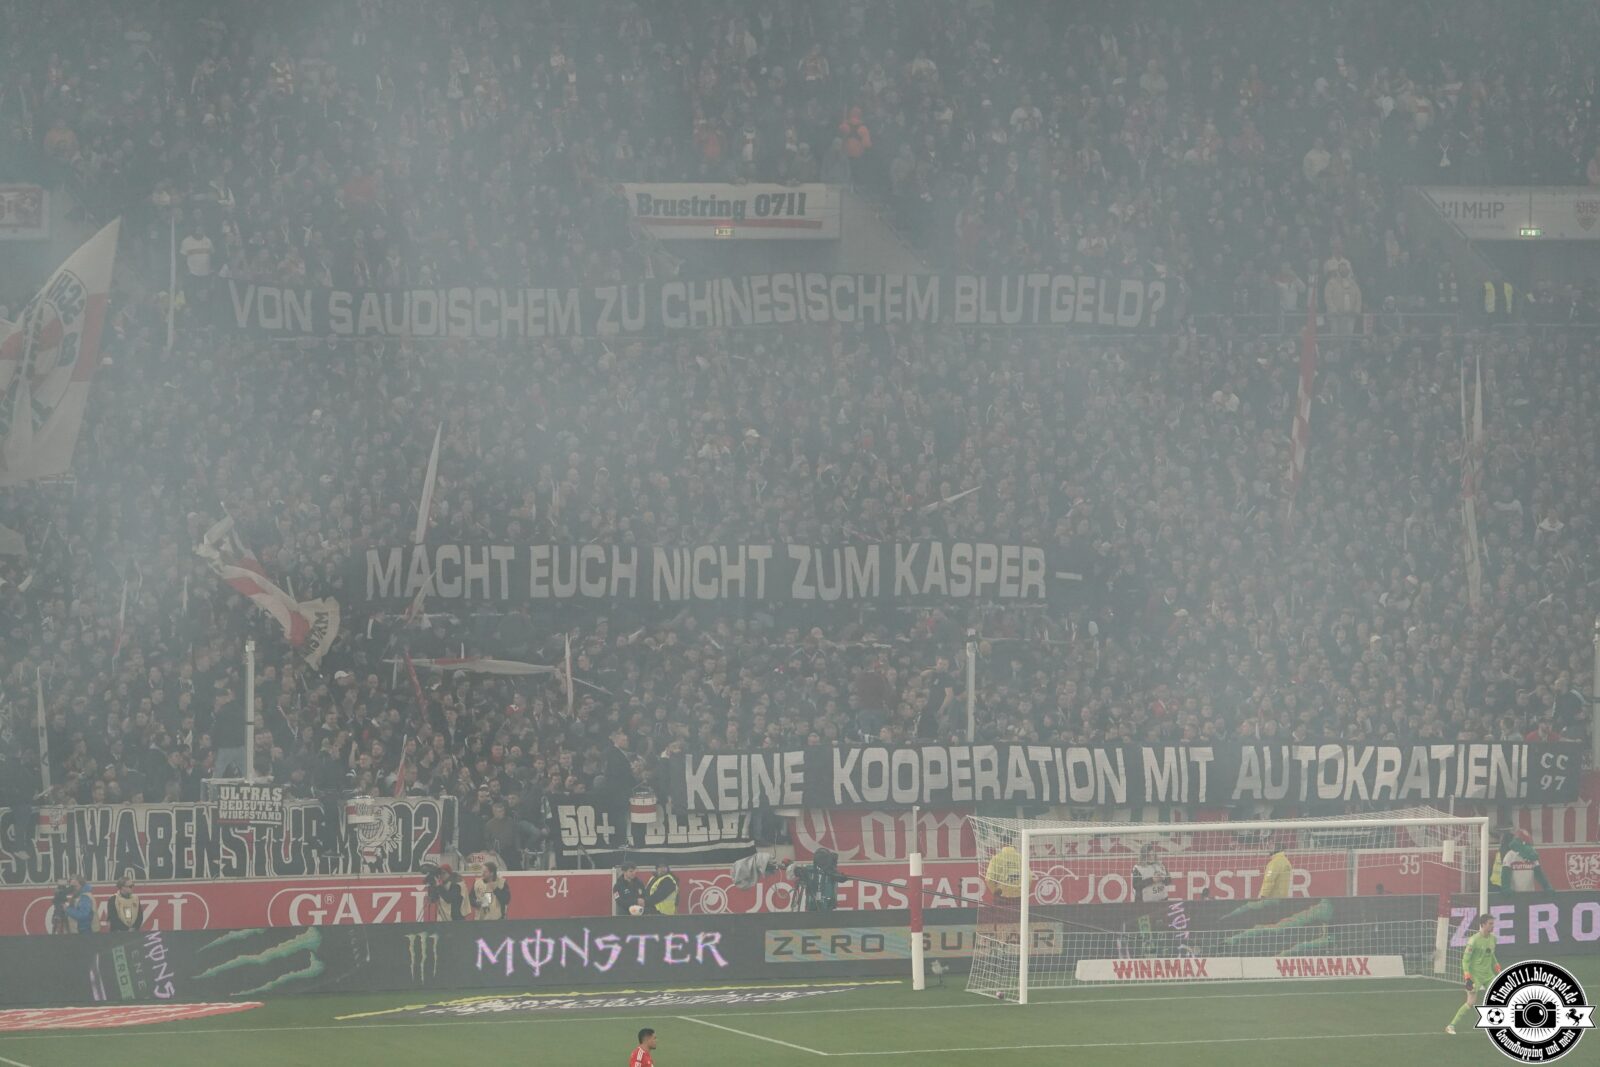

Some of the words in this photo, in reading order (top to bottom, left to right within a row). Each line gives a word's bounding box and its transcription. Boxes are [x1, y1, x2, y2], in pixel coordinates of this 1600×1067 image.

[636, 193, 746, 222] Brustring
[755, 192, 806, 217] 0711
[1462, 201, 1505, 219] MHP
[229, 279, 312, 331] VON
[329, 286, 581, 337] SAUDISCHEM
[594, 283, 646, 333] ZU
[661, 272, 939, 329] CHINESISCHEM
[954, 273, 1166, 327] BLUTGELD?
[366, 545, 515, 600] MACHT
[530, 545, 638, 599] EUCH
[653, 545, 772, 600] NICHT
[788, 544, 880, 600] ZUM
[894, 541, 1046, 599] KASPER
[1540, 752, 1569, 770] CC
[685, 751, 804, 811] KEINE
[832, 745, 1127, 804] KOOPERATION
[1142, 746, 1214, 803] MIT
[1231, 744, 1528, 801] AUTOKRATIEN!
[1540, 774, 1567, 790] 97
[220, 786, 283, 801] ULTRAS
[219, 810, 282, 821] WIDERSTAND
[220, 800, 282, 812] BEDEUTET
[1400, 854, 1421, 876] 35
[545, 877, 569, 899] 34
[746, 876, 986, 914] JOERSTAR
[1079, 869, 1312, 904] JOERSTR
[1450, 902, 1600, 947] ZERO
[475, 928, 728, 977] MONSTER
[772, 934, 885, 956] ZERO
[1112, 958, 1208, 979] WINAMAX
[1275, 957, 1372, 977] WINAMAX
